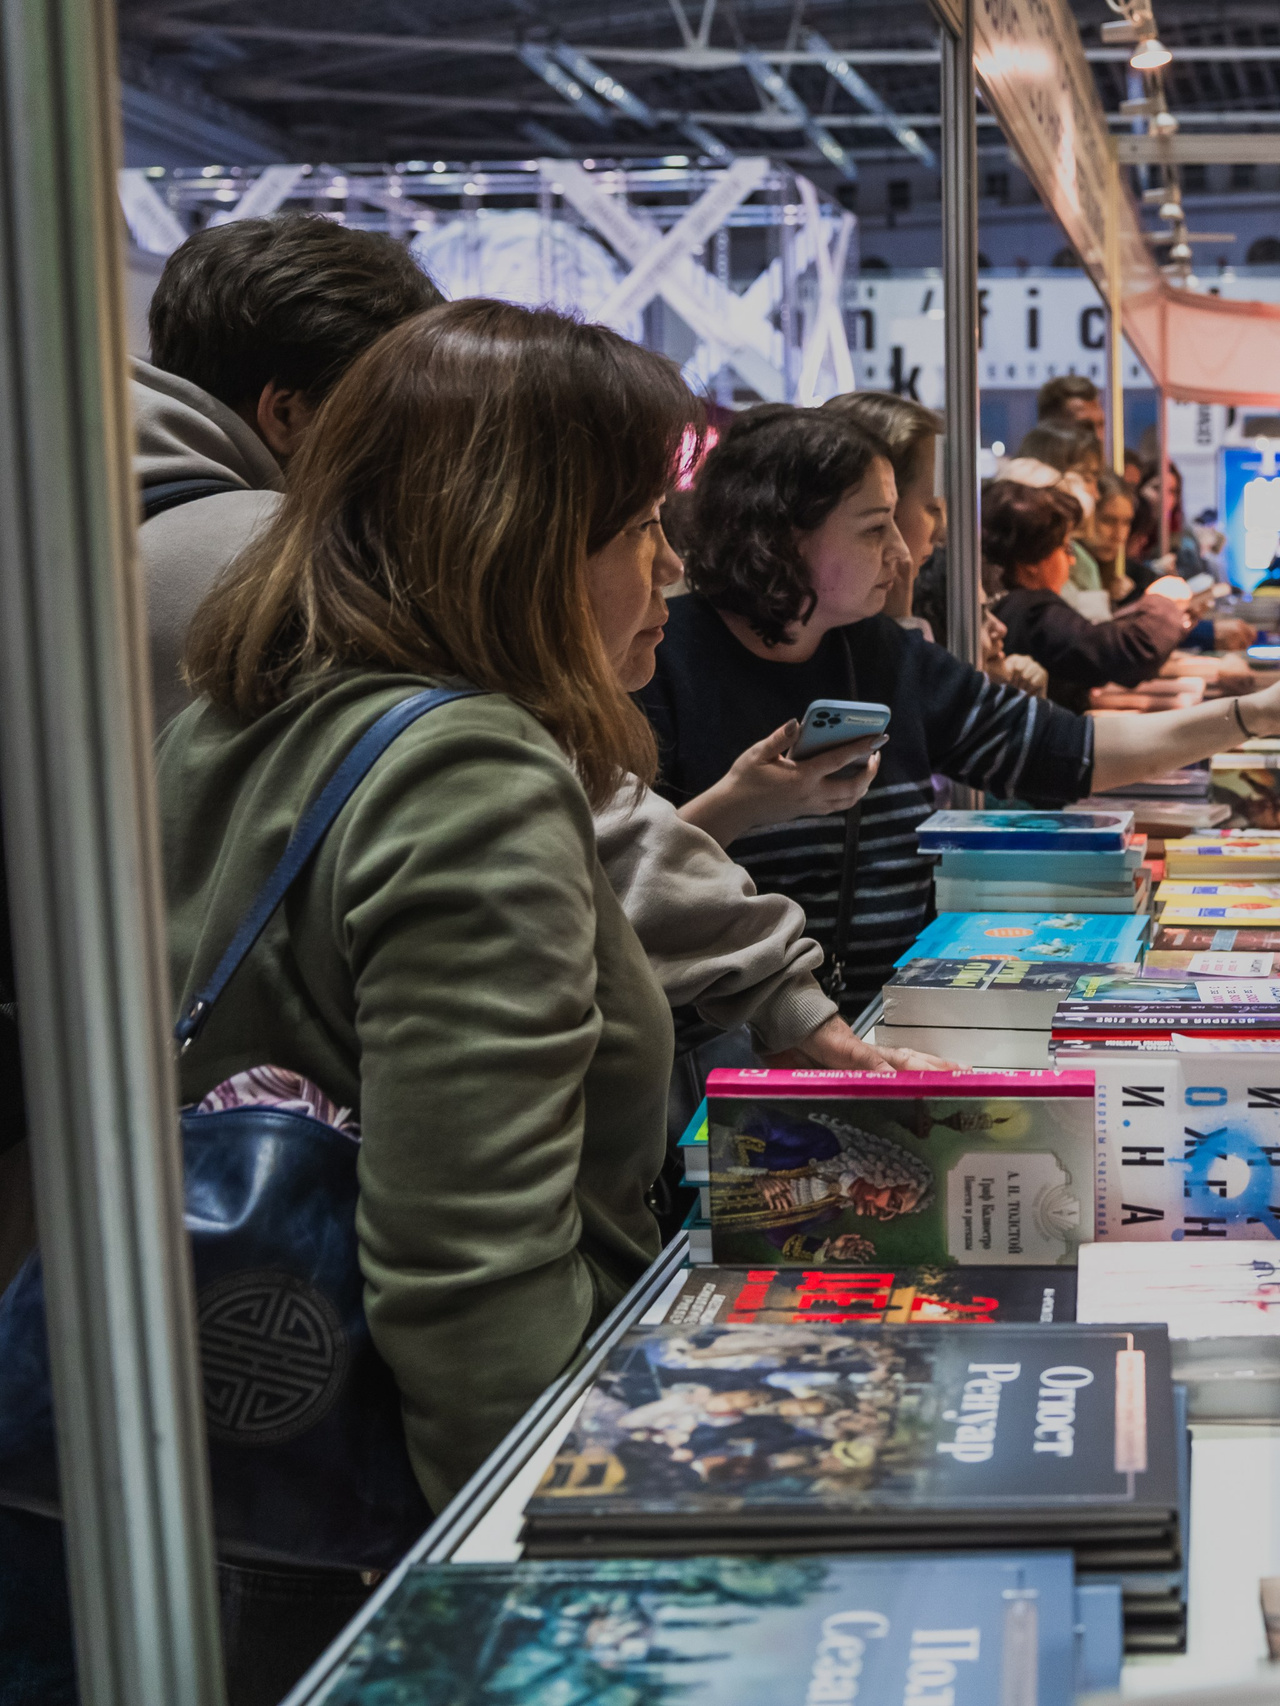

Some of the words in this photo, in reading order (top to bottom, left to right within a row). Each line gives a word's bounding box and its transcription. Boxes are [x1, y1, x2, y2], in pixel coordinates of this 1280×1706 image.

[1096, 1016, 1126, 1024] FINE
[1097, 1084, 1107, 1145] секреты
[978, 1178, 995, 1202] Граф
[1007, 1170, 1020, 1181] А.
[1007, 1185, 1020, 1197] Н.
[1097, 1152, 1109, 1237] счастливой
[978, 1204, 995, 1250] Калиостро
[1007, 1200, 1023, 1254] ТОЛСТОЙ
[936, 1361, 1022, 1463] Ренуар
[805, 1610, 892, 1706] Сеза
